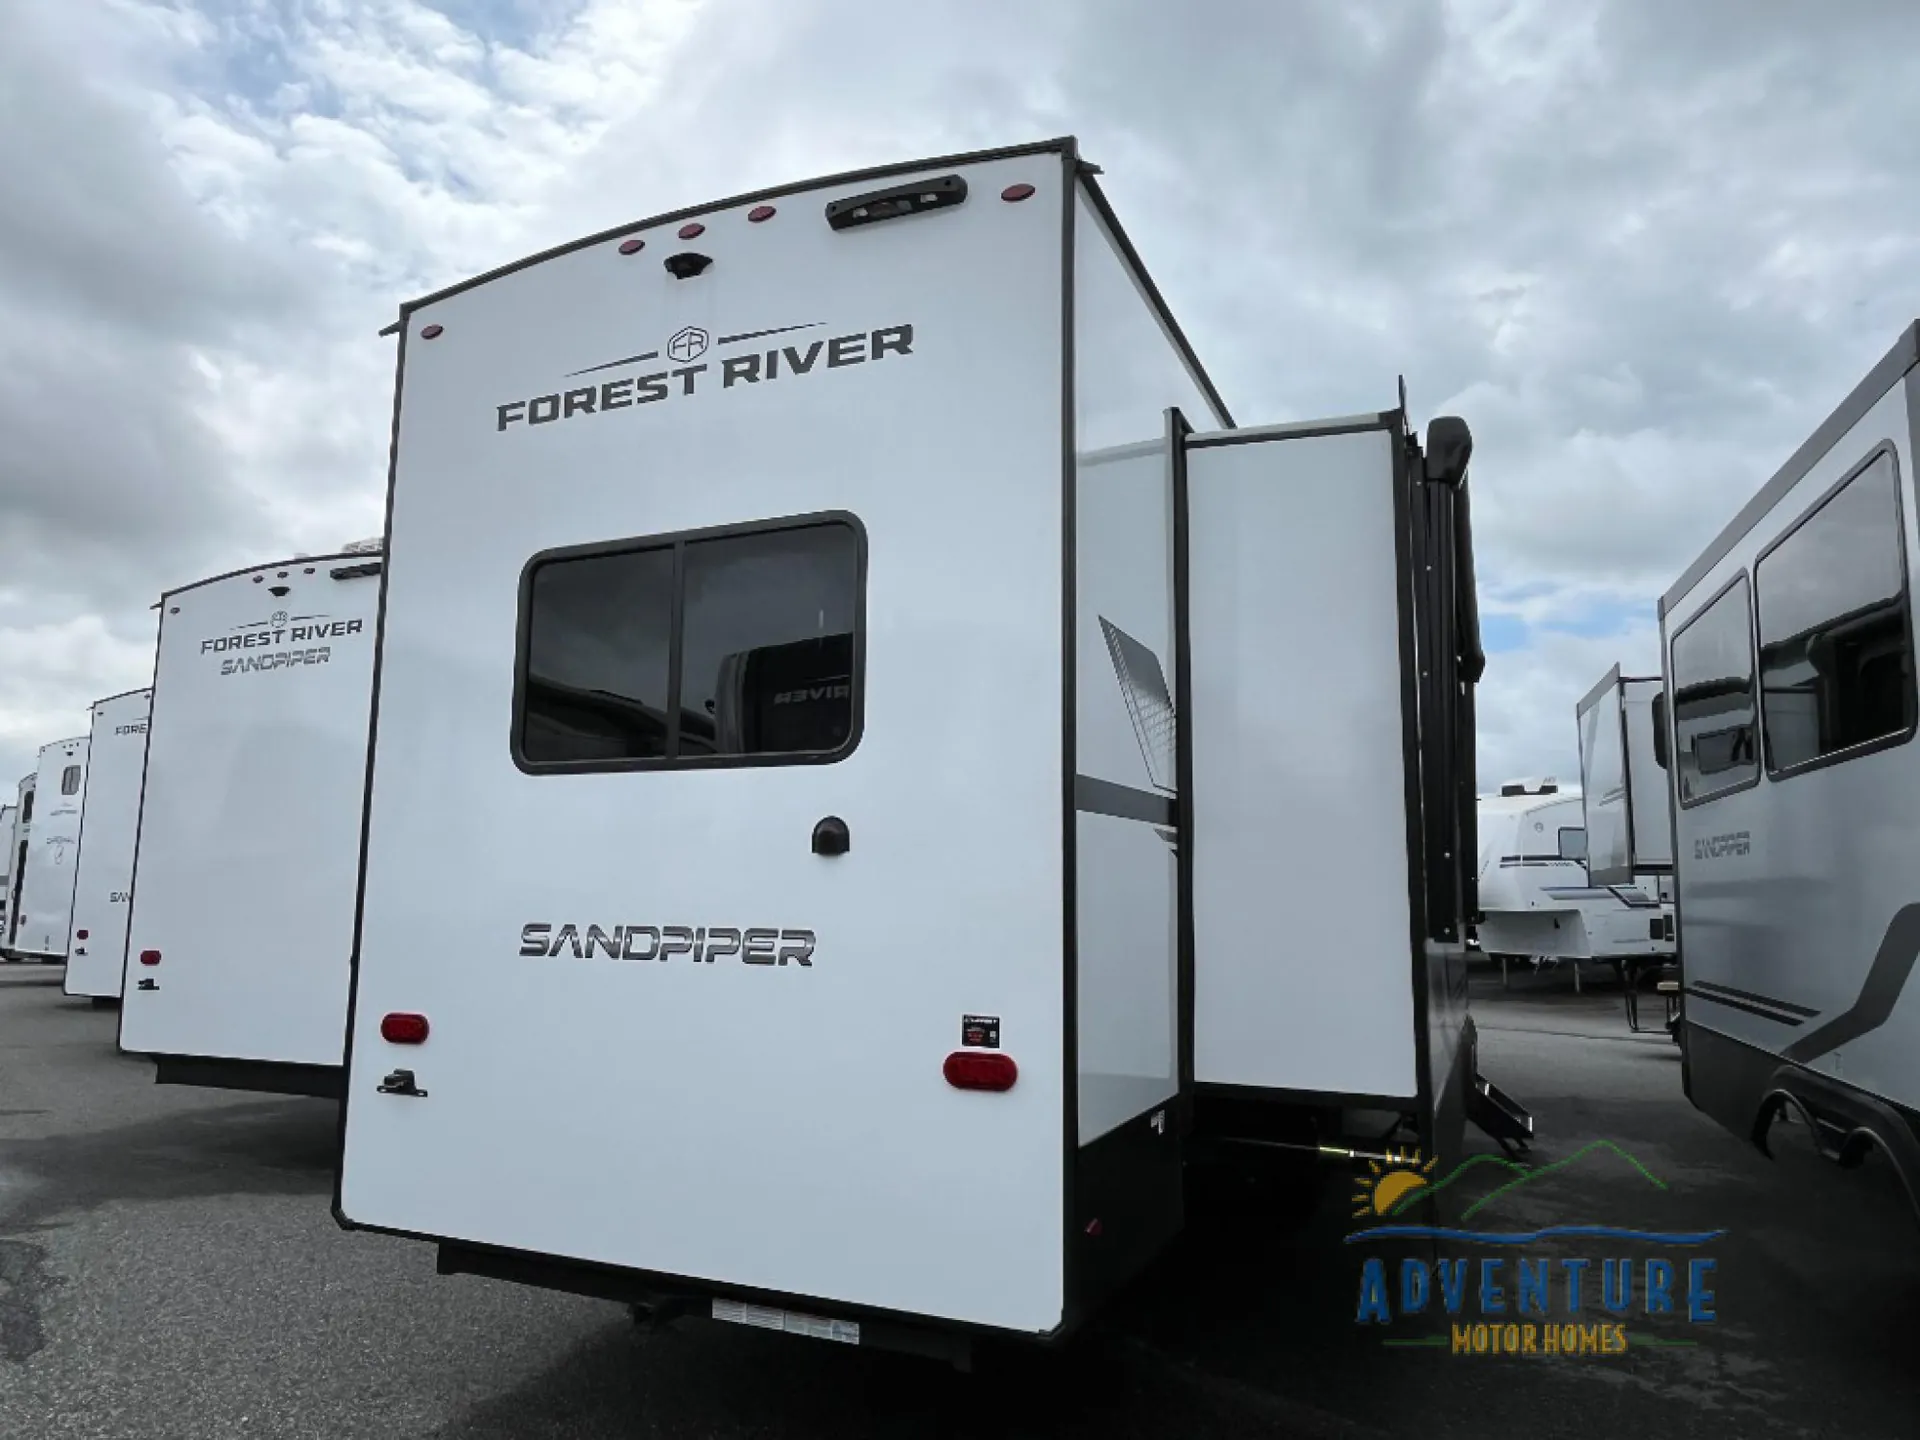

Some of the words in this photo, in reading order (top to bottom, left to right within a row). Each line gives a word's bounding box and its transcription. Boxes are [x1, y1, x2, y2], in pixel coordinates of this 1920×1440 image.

[496, 364, 708, 431] FOREST
[721, 323, 914, 388] RIVER
[200, 629, 286, 655] FOREST
[290, 618, 363, 642] RIVER
[220, 646, 331, 675] SANDPIPER
[519, 923, 816, 967] SANDPIPER
